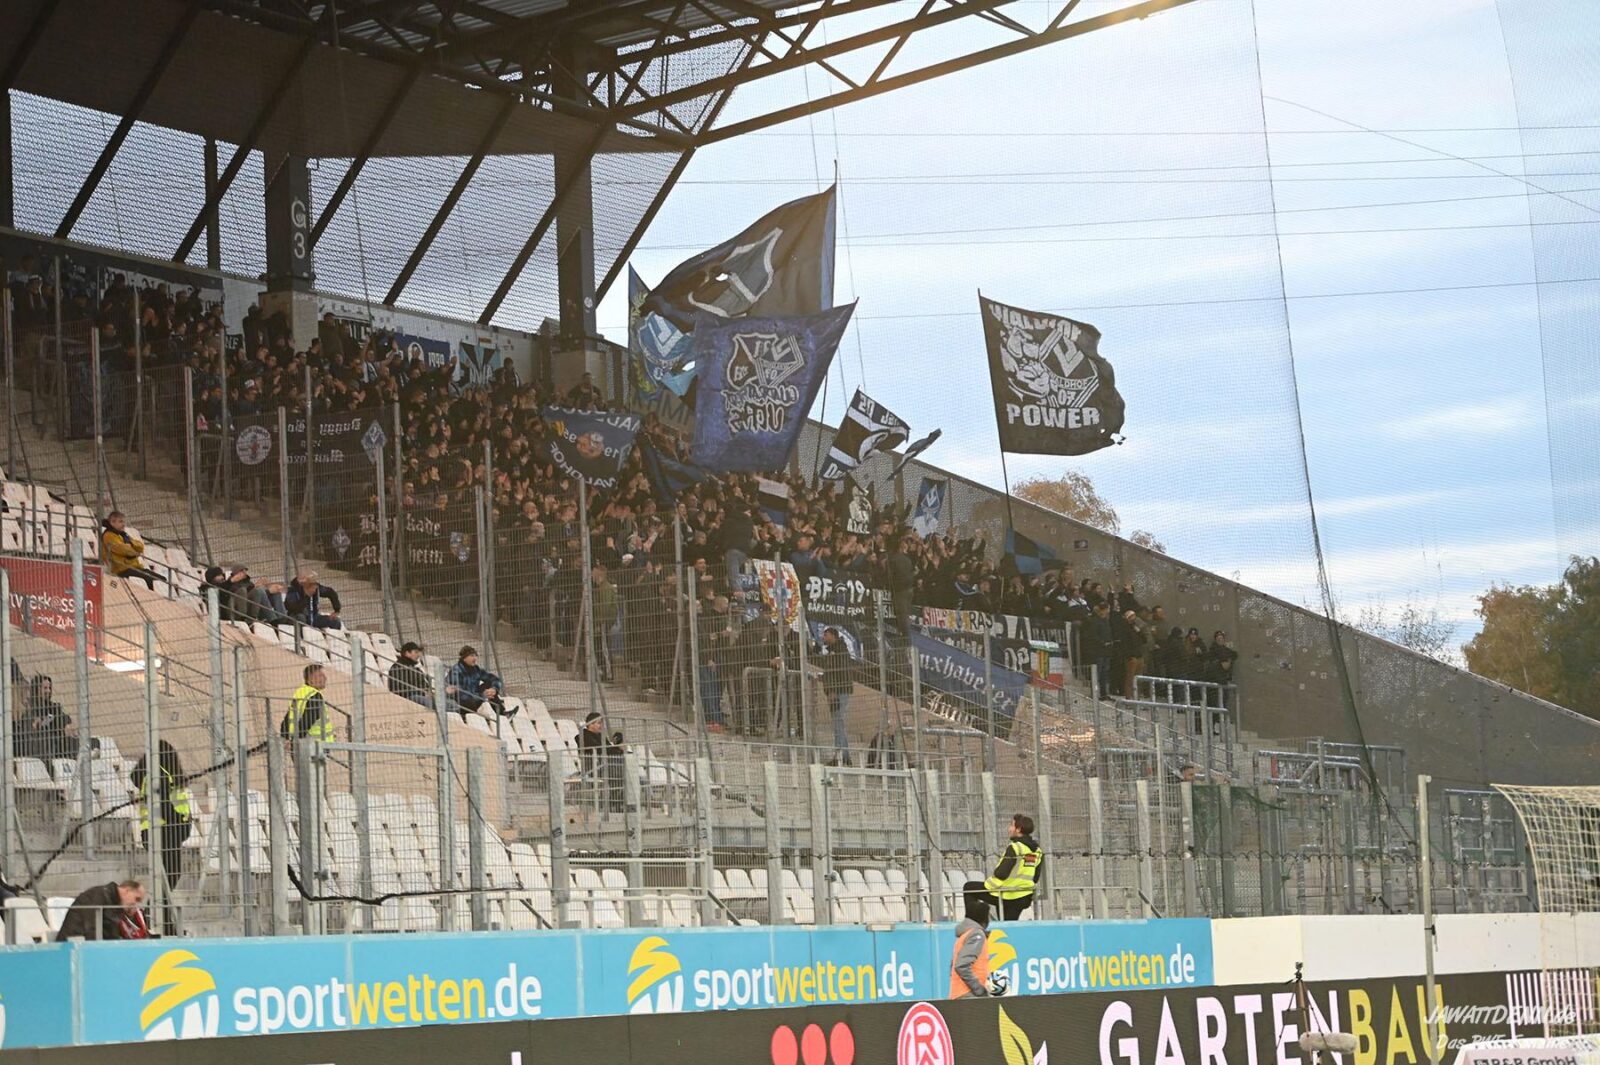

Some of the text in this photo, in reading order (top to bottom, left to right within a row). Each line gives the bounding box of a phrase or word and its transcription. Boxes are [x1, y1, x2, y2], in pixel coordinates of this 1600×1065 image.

[291, 200, 306, 228] G
[294, 232, 305, 259] 3
[1006, 403, 1100, 429] POWER
[694, 951, 914, 1010] sportwetten.de
[1027, 943, 1195, 993] sportwetten.de
[233, 963, 542, 1034] sportwetten.de
[1099, 983, 1447, 1065] GARTENBAU
